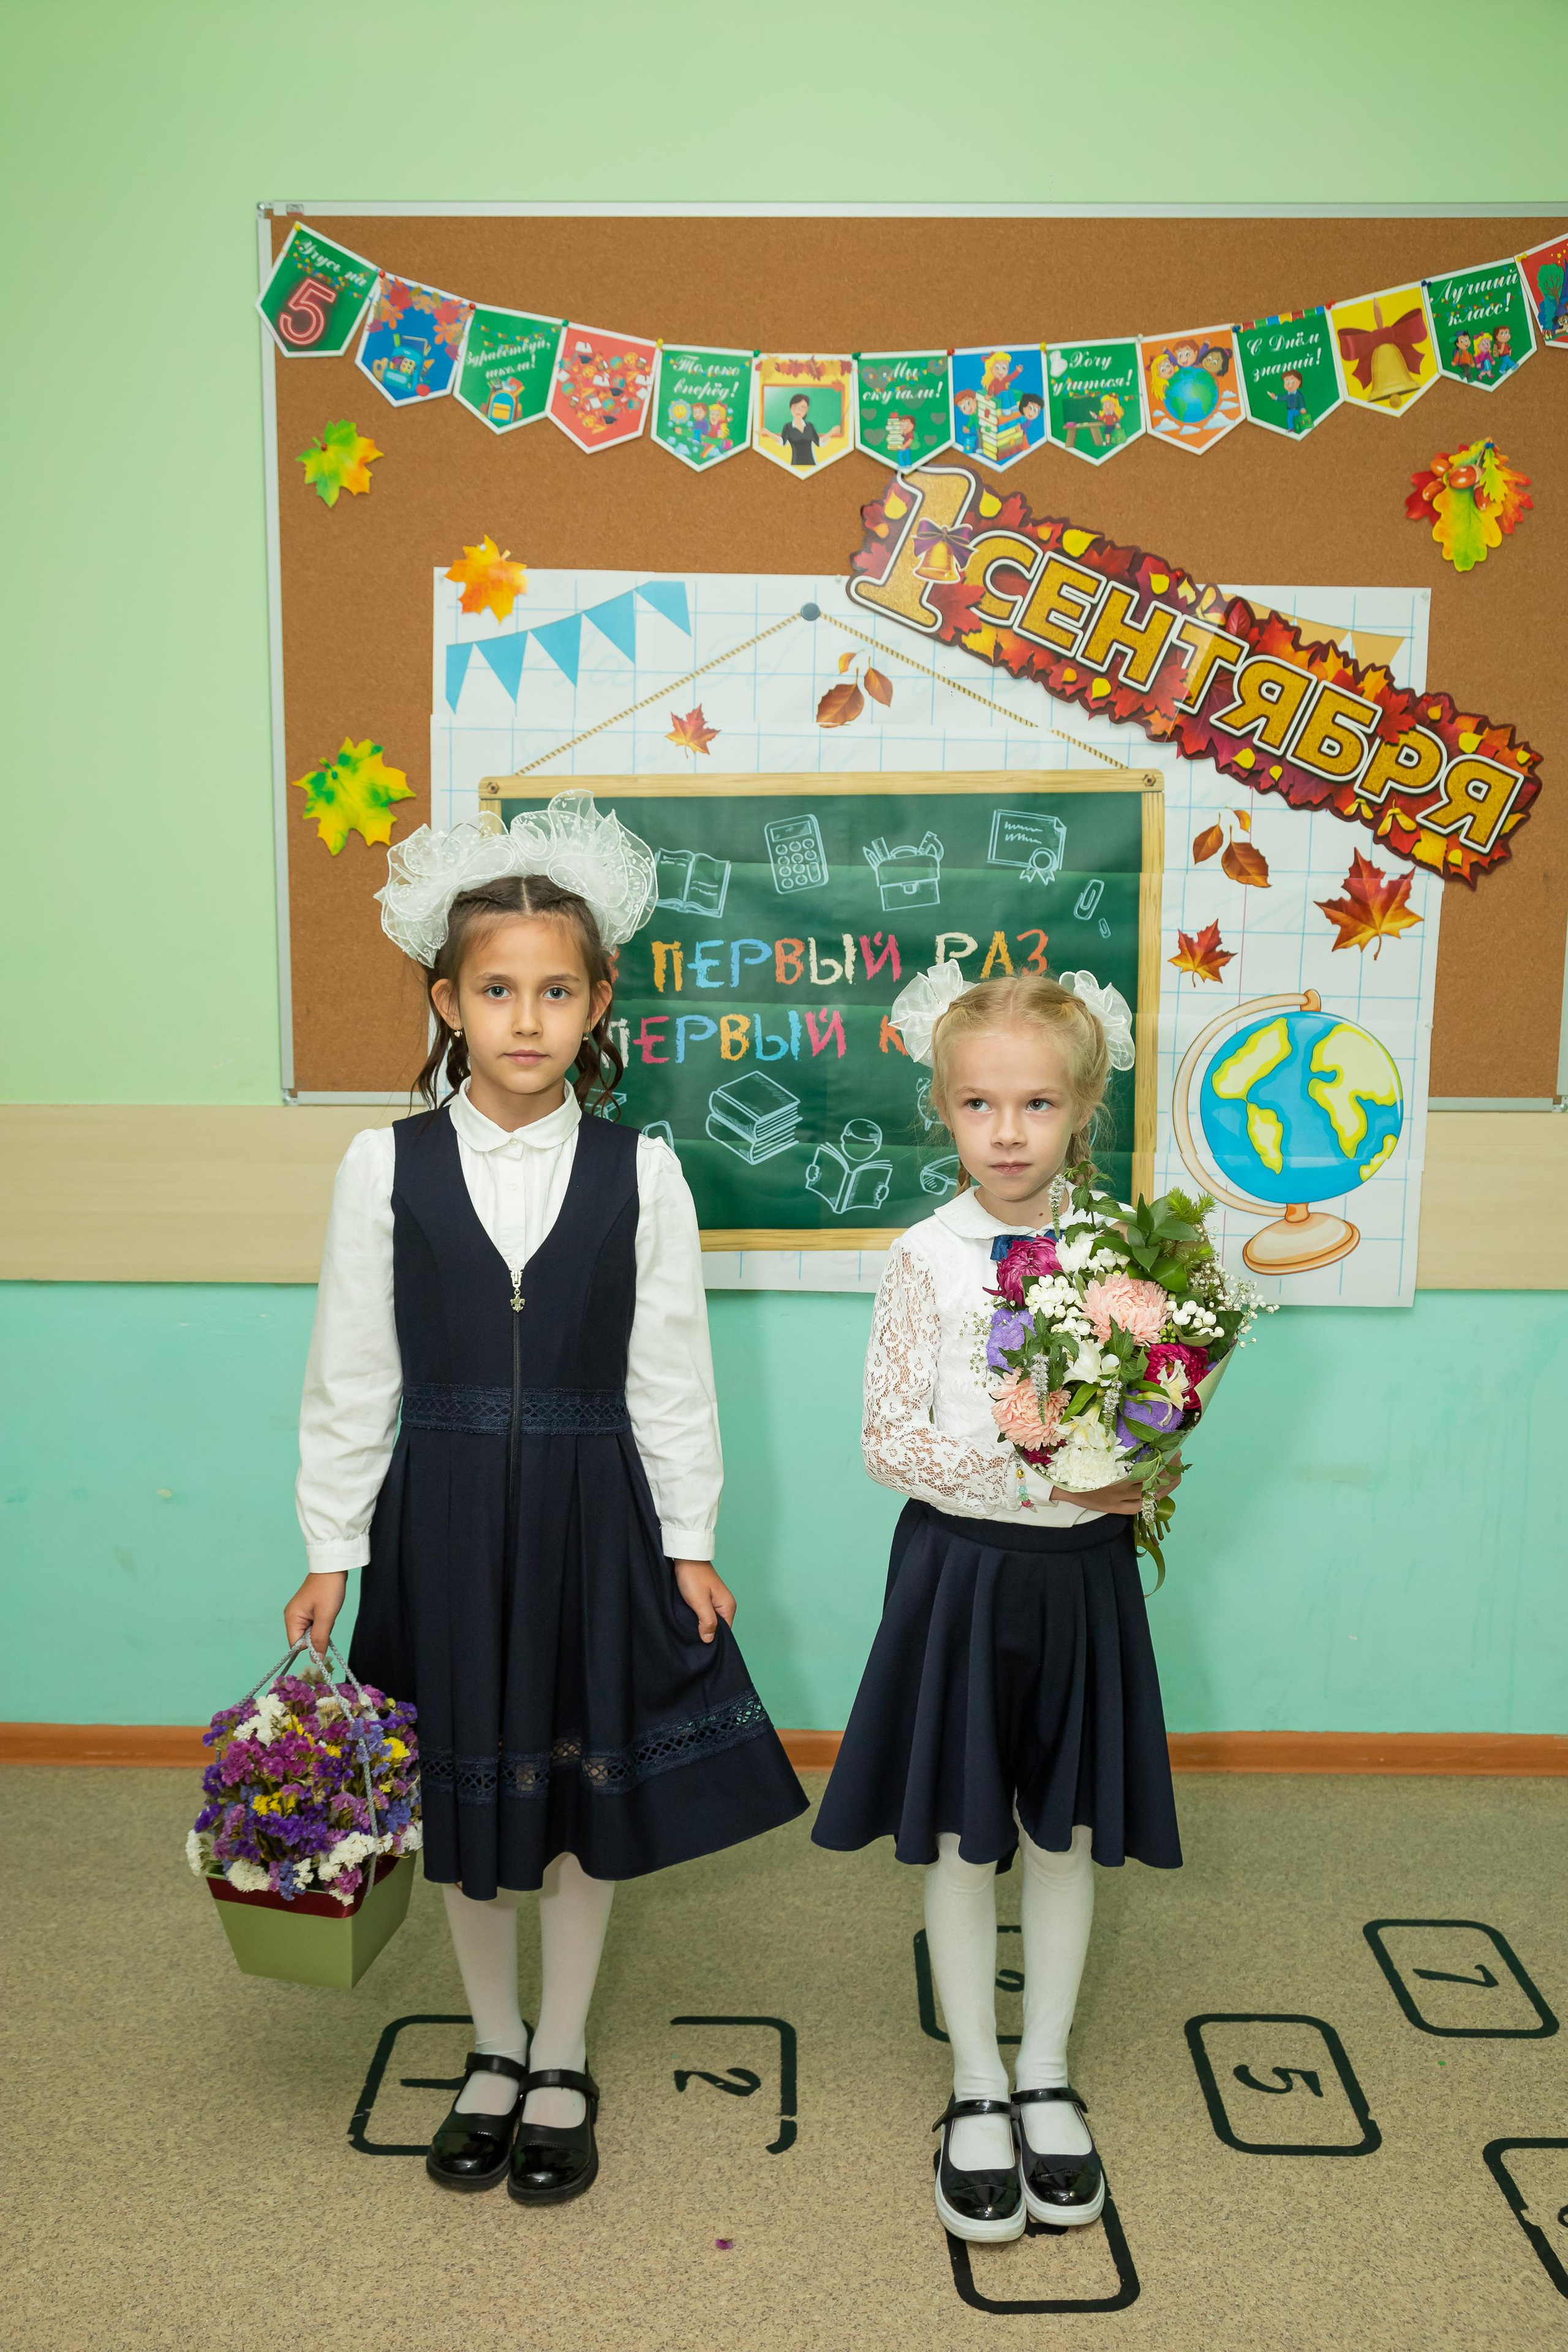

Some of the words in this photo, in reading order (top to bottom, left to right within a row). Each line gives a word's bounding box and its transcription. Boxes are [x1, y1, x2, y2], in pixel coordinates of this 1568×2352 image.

[298, 238, 341, 273] Учусь
[344, 271, 367, 287] на
[1430, 268, 1517, 304] Лучший
[279, 277, 336, 345] 5
[1447, 292, 1511, 326] класс!
[1246, 337, 1262, 356] С
[1268, 331, 1320, 352] Днём
[486, 353, 535, 379] школа!
[673, 355, 740, 376] Только
[883, 360, 918, 378] Мы
[1069, 350, 1112, 371] Хочу
[1253, 347, 1321, 383] знаний!
[674, 377, 739, 401] вперёд!
[862, 380, 943, 405] скучали!
[1053, 369, 1133, 397] учиться!
[846, 467, 976, 632] 1
[974, 529, 1525, 853] СЕНТЯБРЯ
[651, 931, 902, 992] ПЕРВЫЙ
[935, 929, 1049, 979] РАЗ
[1232, 2062, 1323, 2097] 5
